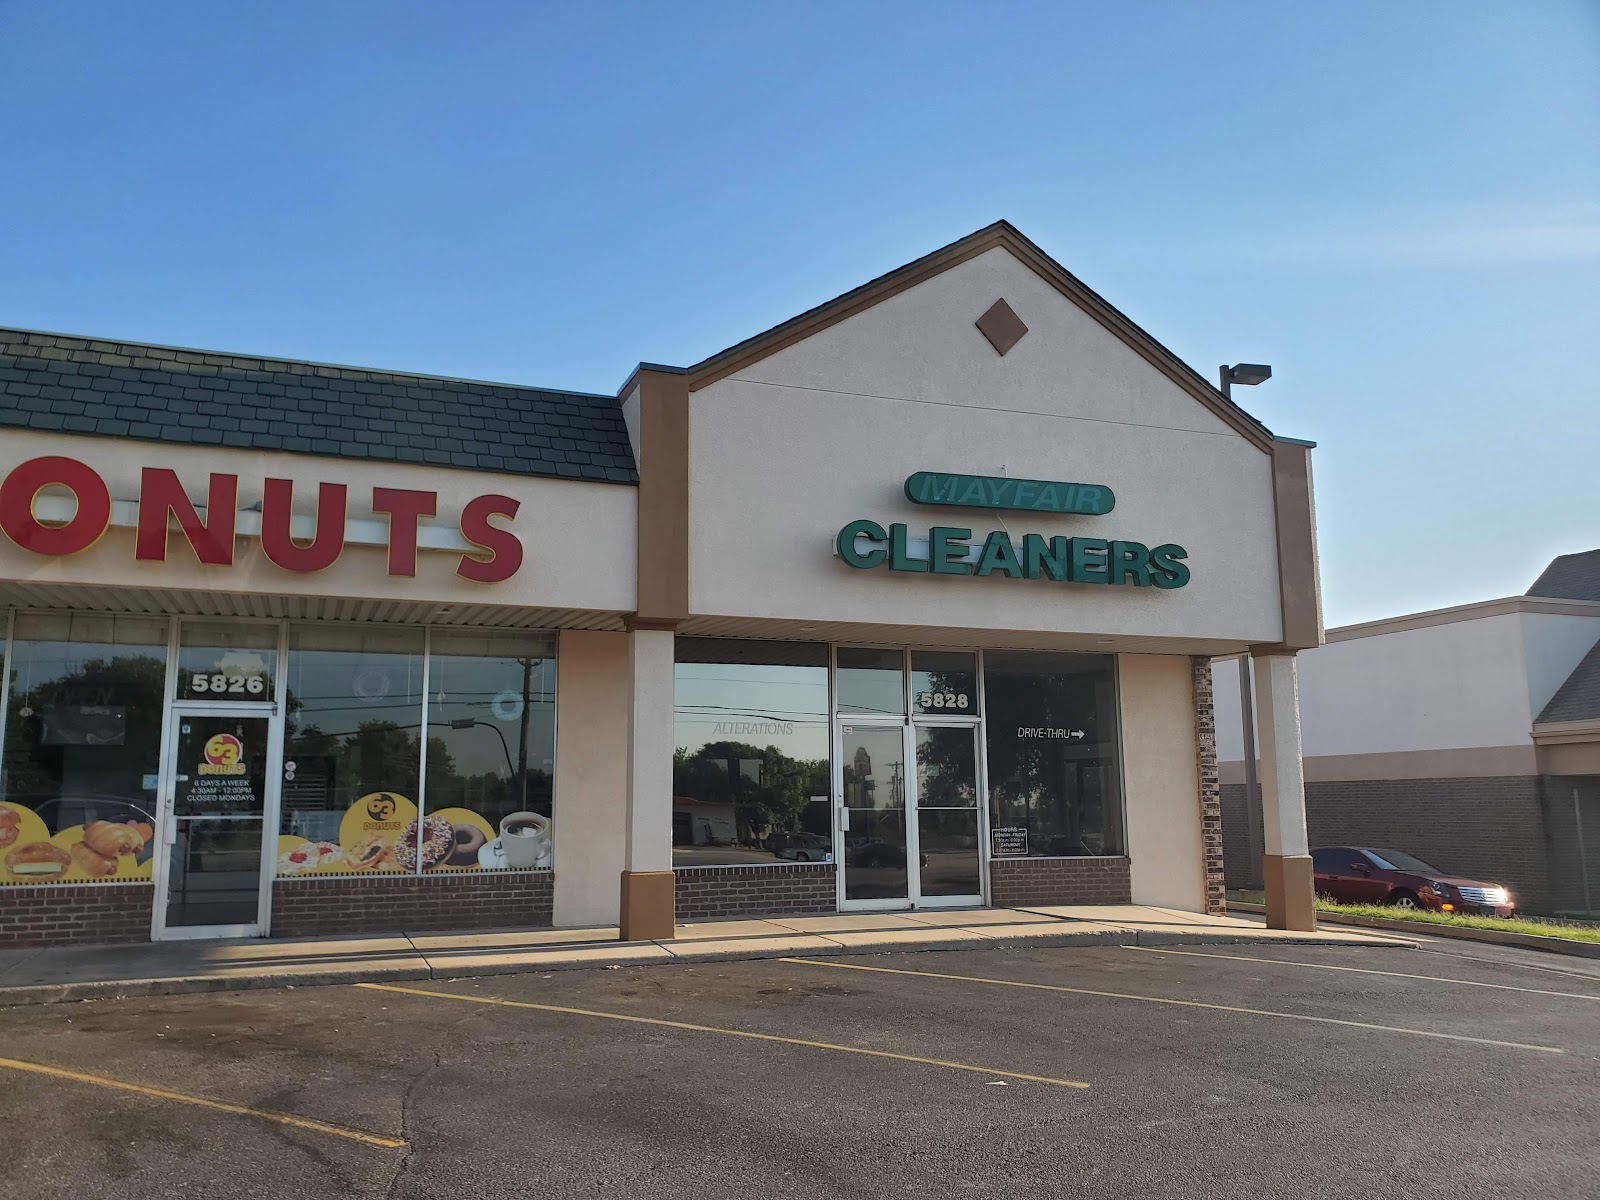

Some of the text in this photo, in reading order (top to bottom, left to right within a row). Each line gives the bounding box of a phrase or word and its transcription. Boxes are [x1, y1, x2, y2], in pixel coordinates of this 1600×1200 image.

[919, 475, 1100, 511] MAYFAIR
[0, 456, 524, 583] ONUTS
[836, 519, 1190, 589] CLEANERS
[192, 674, 264, 694] 5826
[921, 692, 969, 708] 5828
[713, 722, 794, 735] ALTERATIONS
[1017, 727, 1071, 739] DRIVE-THRU
